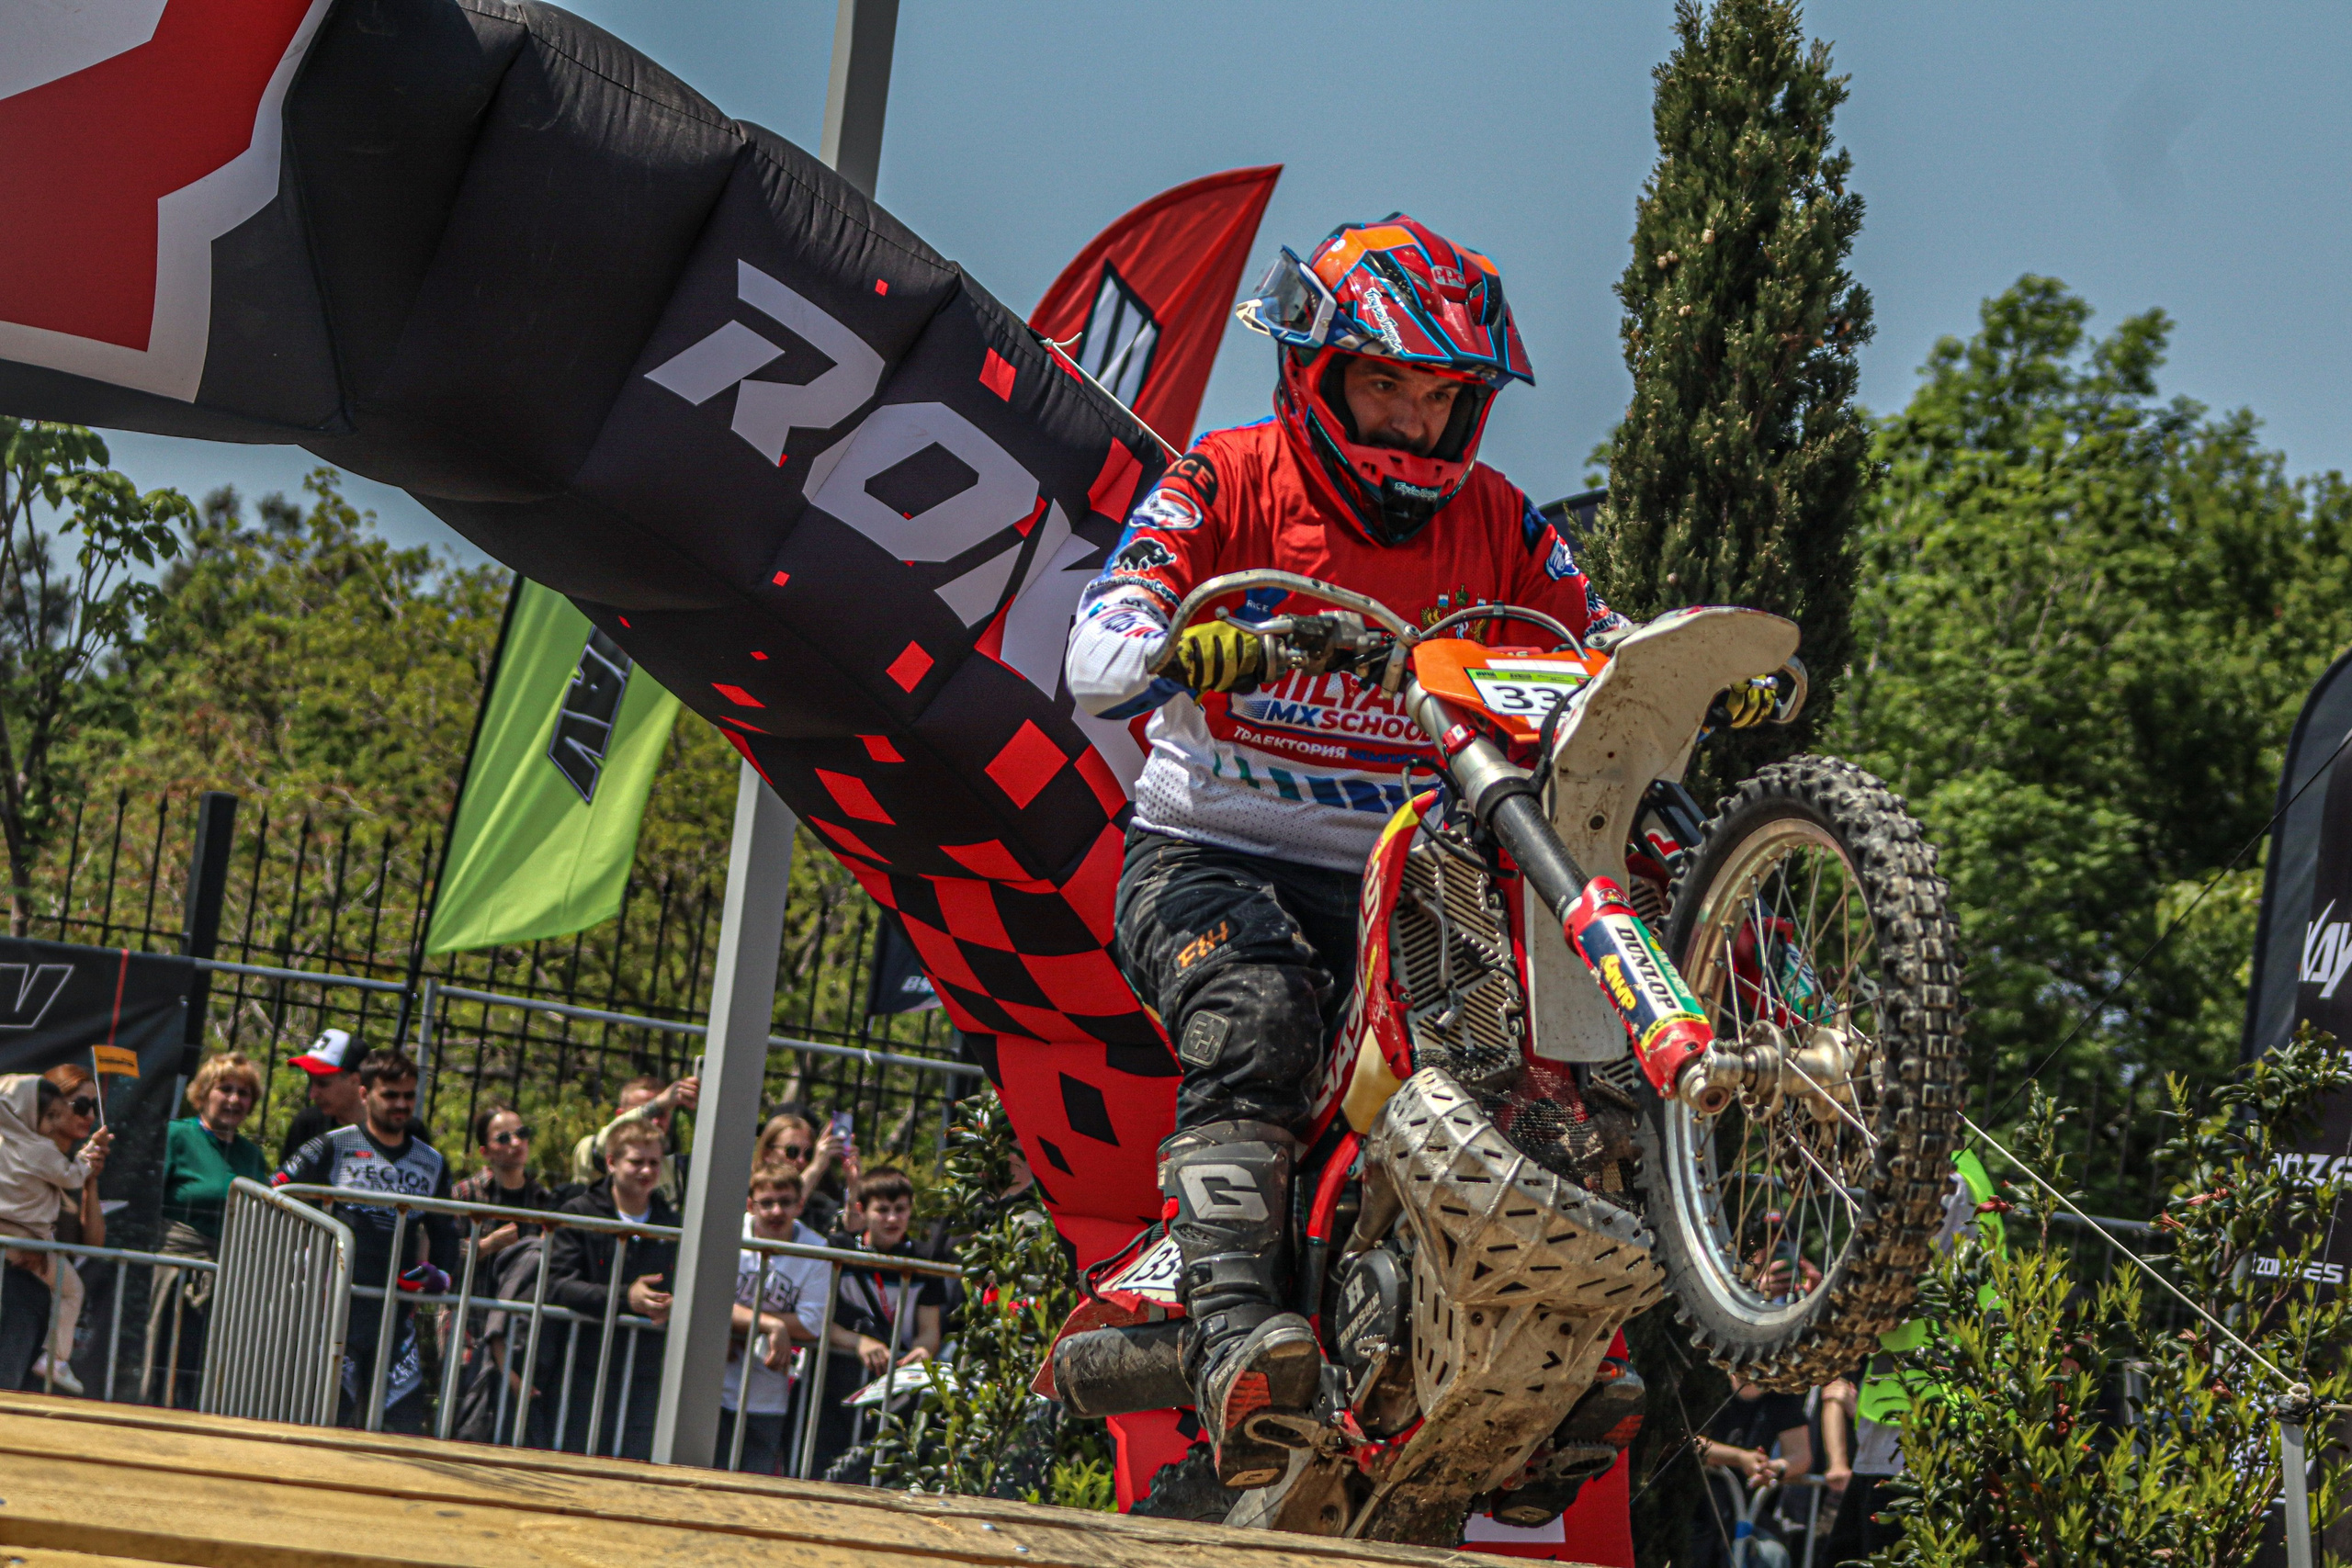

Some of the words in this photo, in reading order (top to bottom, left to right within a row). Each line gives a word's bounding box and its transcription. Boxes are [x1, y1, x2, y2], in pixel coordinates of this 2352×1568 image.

[1246, 599, 1269, 613] RICE
[1233, 725, 1348, 761] ТРАЕКТОРИЯ
[1614, 926, 1677, 1010] DUNLOP
[1179, 1164, 1270, 1223] G
